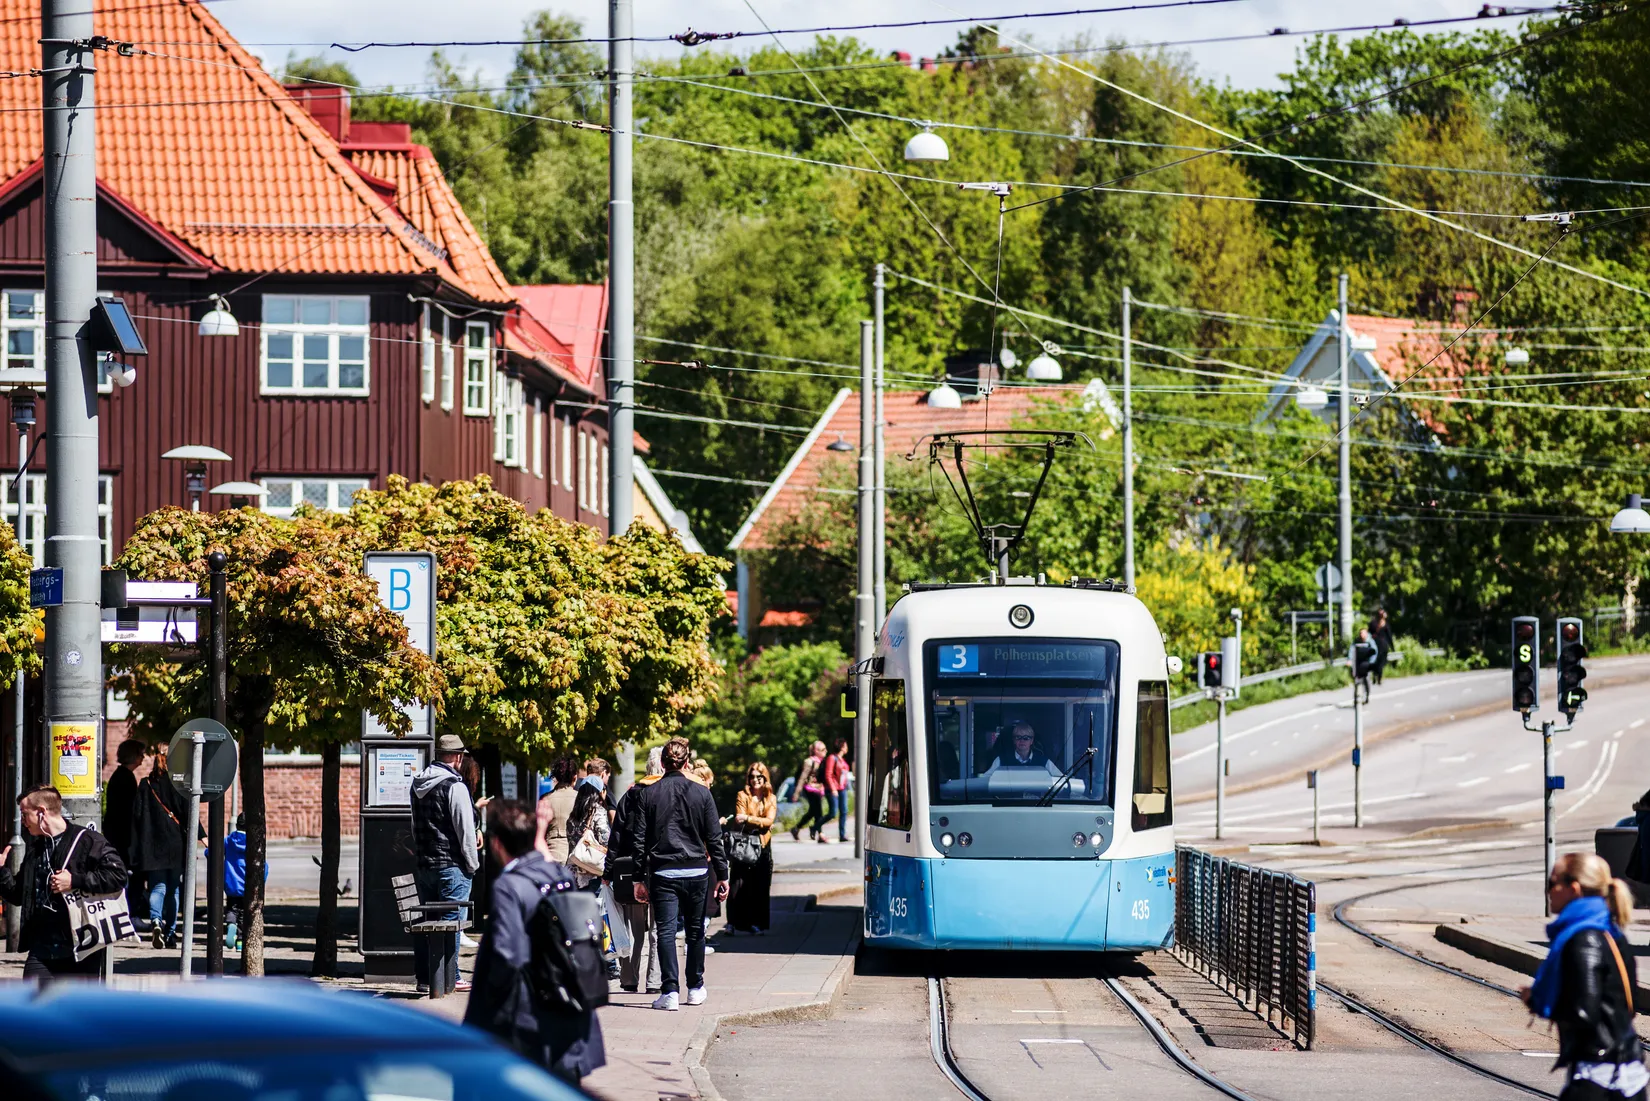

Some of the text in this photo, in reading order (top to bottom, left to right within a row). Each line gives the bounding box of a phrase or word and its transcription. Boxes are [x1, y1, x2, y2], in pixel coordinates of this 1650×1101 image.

[389, 568, 411, 611] B
[952, 644, 1093, 669] 3 Polhemsplatsen
[87, 901, 106, 914] OR
[889, 896, 907, 917] 435
[1131, 899, 1150, 920] 435
[75, 911, 135, 953] DIE
